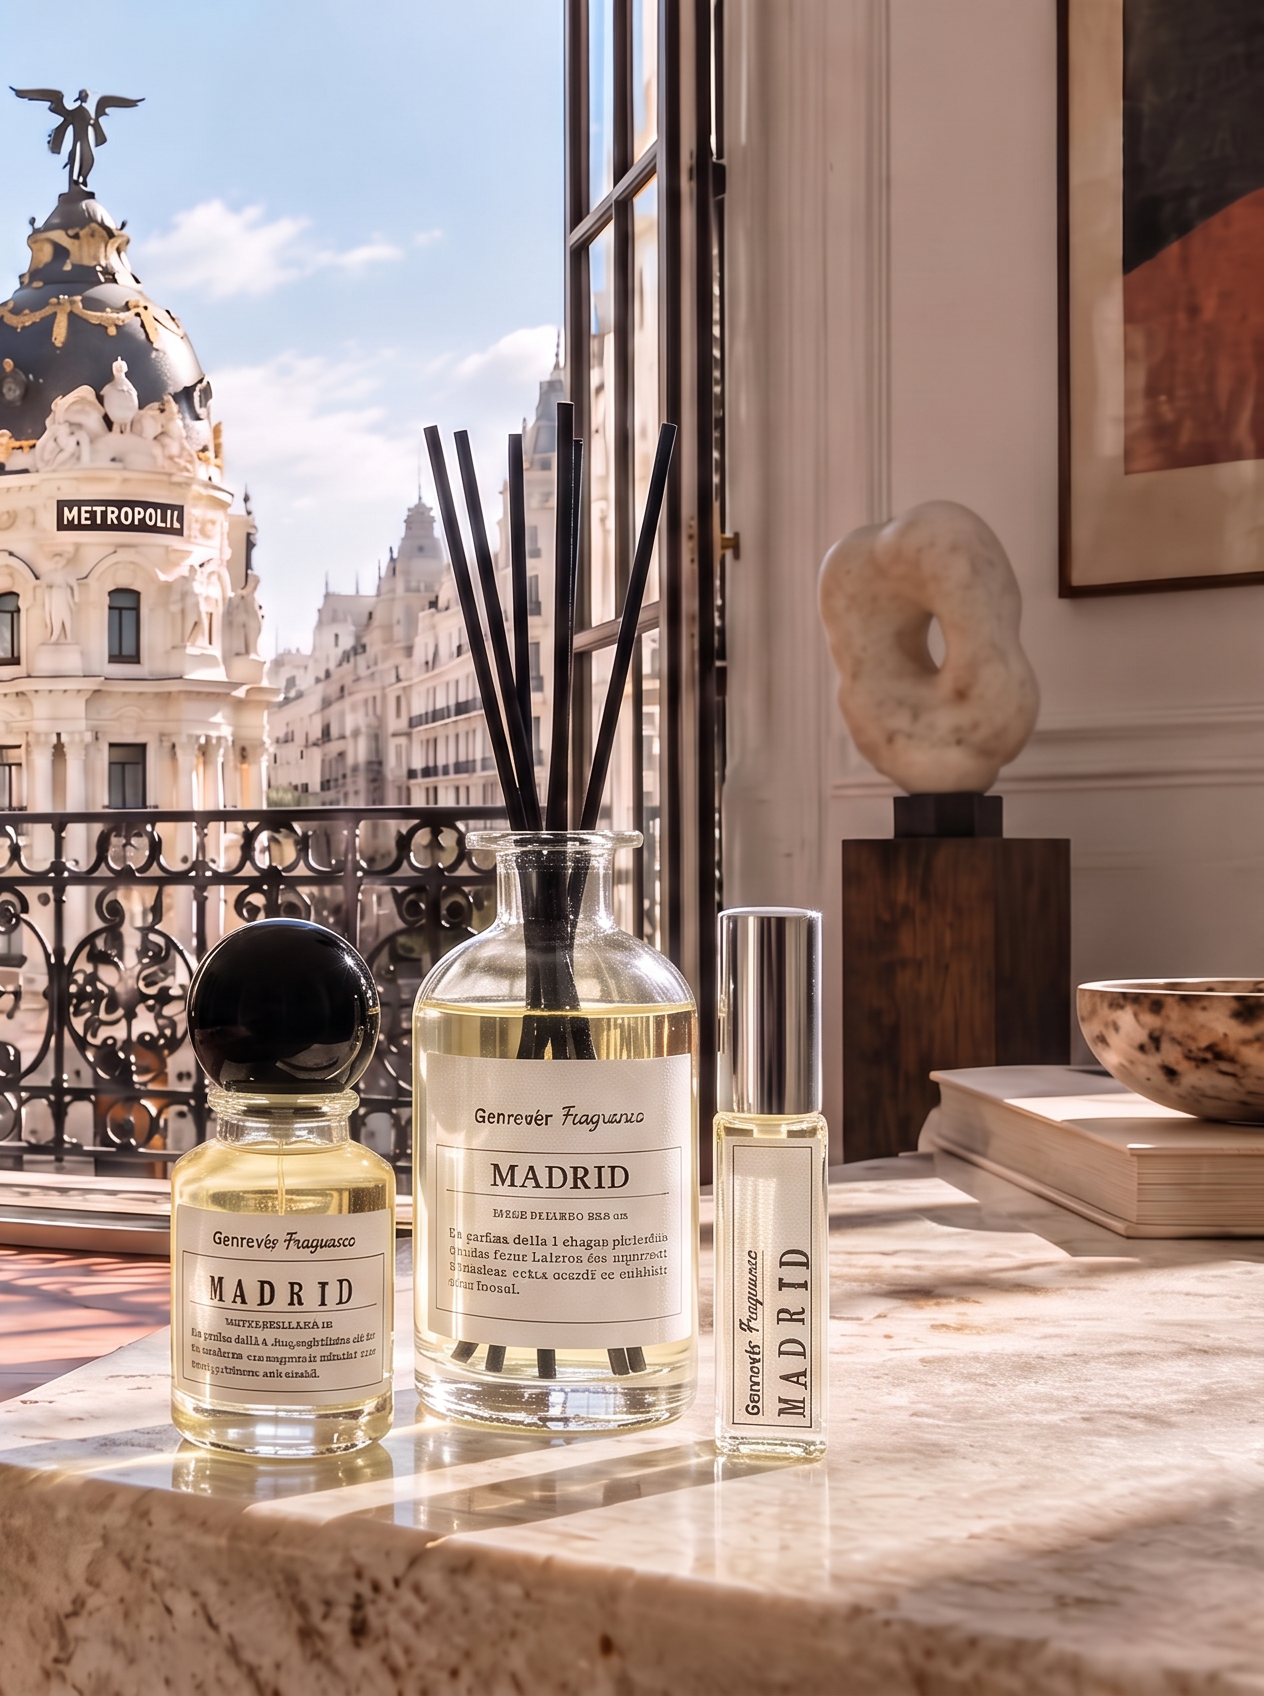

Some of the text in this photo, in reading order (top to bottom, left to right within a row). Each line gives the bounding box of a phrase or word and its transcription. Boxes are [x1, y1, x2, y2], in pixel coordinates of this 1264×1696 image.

[490, 1163, 630, 1190] MADRID
[209, 1275, 353, 1307] MADRID
[776, 1249, 810, 1418] MADRID
